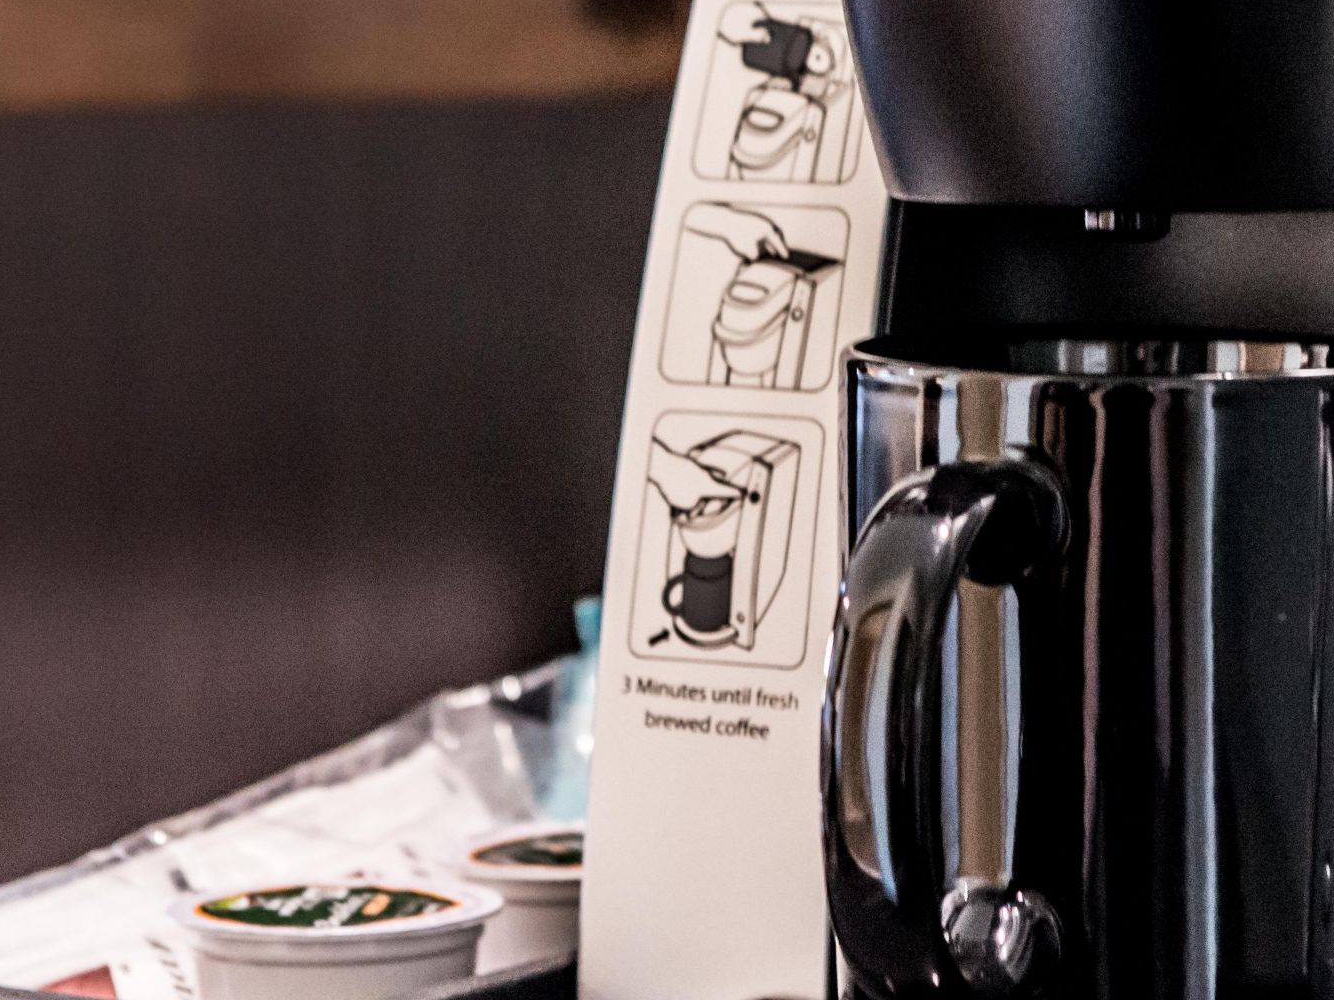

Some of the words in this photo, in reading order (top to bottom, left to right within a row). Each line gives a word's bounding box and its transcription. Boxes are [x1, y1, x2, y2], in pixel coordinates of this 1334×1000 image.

[622, 675, 632, 693] 3
[636, 676, 707, 701] Minutes
[711, 685, 751, 706] until
[756, 688, 799, 710] fresh
[644, 710, 711, 733] brewed
[716, 718, 770, 739] coffee
